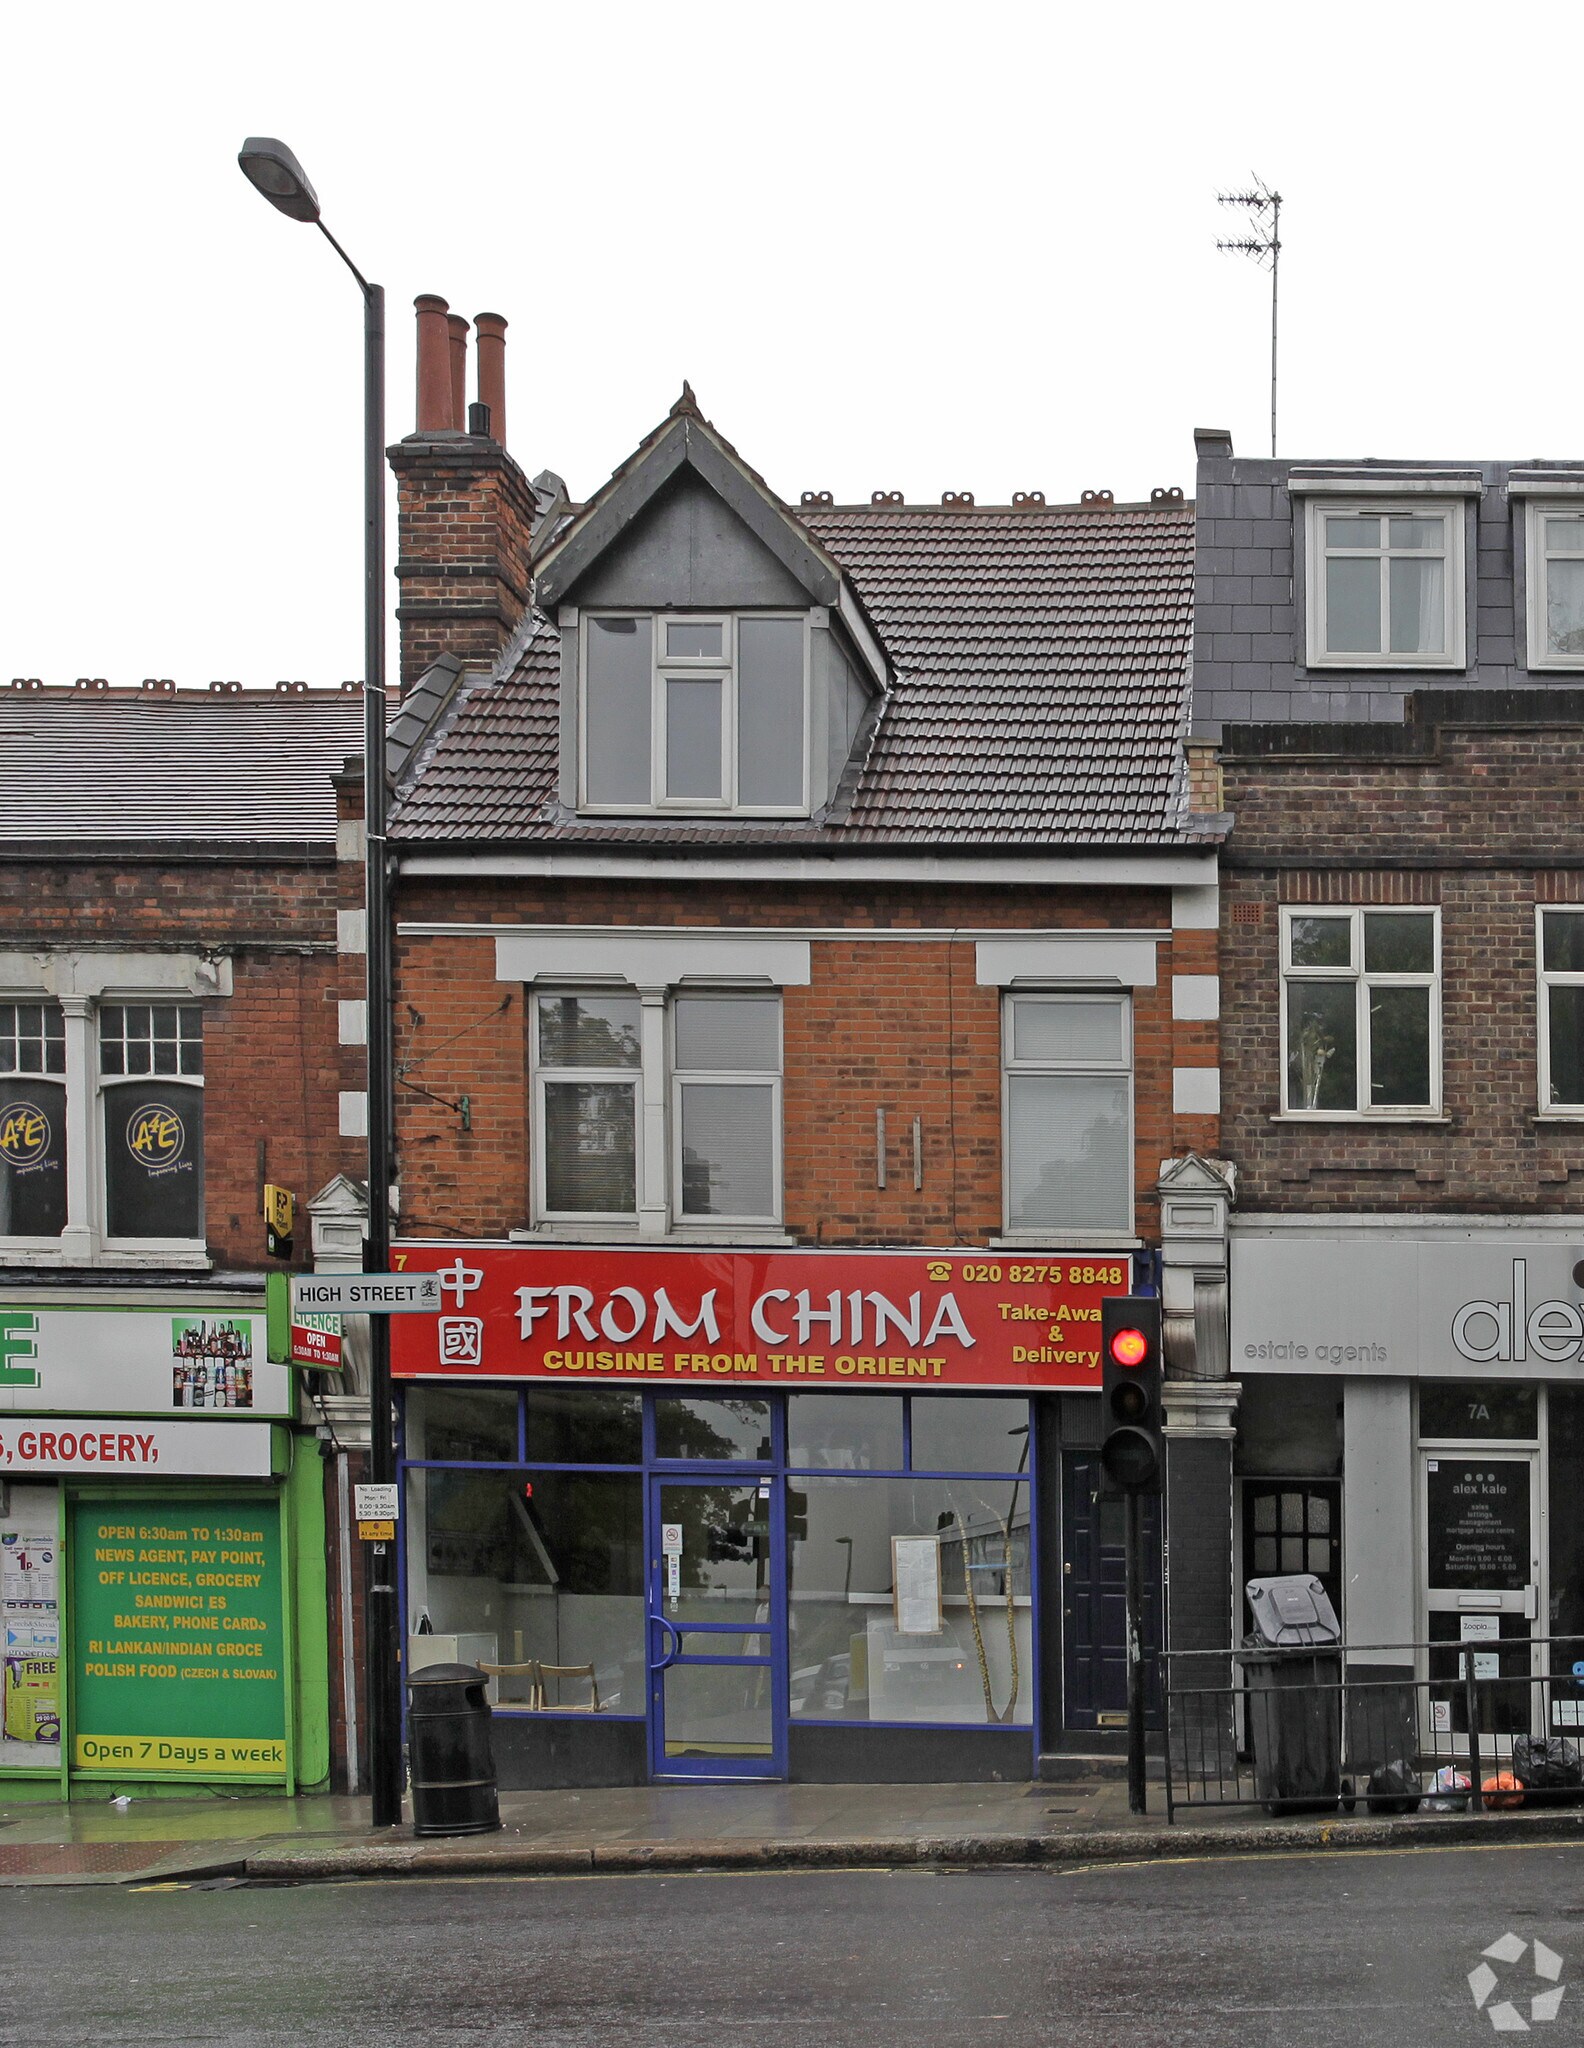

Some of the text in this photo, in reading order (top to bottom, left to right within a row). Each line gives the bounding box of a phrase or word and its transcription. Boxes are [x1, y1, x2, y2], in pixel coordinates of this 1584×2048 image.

[131, 1113, 179, 1151] A4E
[16, 1163, 43, 1177] mproving
[394, 1254, 407, 1272] 7
[962, 1264, 1122, 1284] 020 8275 8848
[300, 1286, 416, 1302] HIGH STREET
[513, 1285, 977, 1348] FROM CHINA
[998, 1303, 1102, 1322] Take-Awa
[306, 1332, 326, 1348] OPEN
[1048, 1325, 1064, 1342] &
[313, 1349, 321, 1359] TO
[1012, 1346, 1100, 1368] Delivery
[1244, 1341, 1388, 1366] estate agents
[543, 1350, 946, 1377] CUISINE FROM THE ORIENT
[1468, 1404, 1490, 1420] 7A
[18, 1431, 159, 1464] GROCERY,
[1090, 1491, 1098, 1503] 7
[1453, 1483, 1507, 1495] alex kale
[98, 1526, 264, 1542] OPEN 6:30am TO 1:30am
[375, 1544, 383, 1553] 2
[95, 1548, 266, 1567] NEWS AGENT, PAY POINT,
[98, 1571, 261, 1588] OFF LICENCE, GROCERY
[114, 1615, 170, 1631] BAKERY,
[173, 1616, 219, 1630] PHONE
[106, 1641, 213, 1656] LANKAN/INDIAN
[216, 1643, 263, 1657] GROCE
[26, 1661, 56, 1675] FREE
[85, 1662, 277, 1680] POLISH FOOD (CZECH & SLOVAK)
[83, 1741, 283, 1763] Open 7 Days a week
